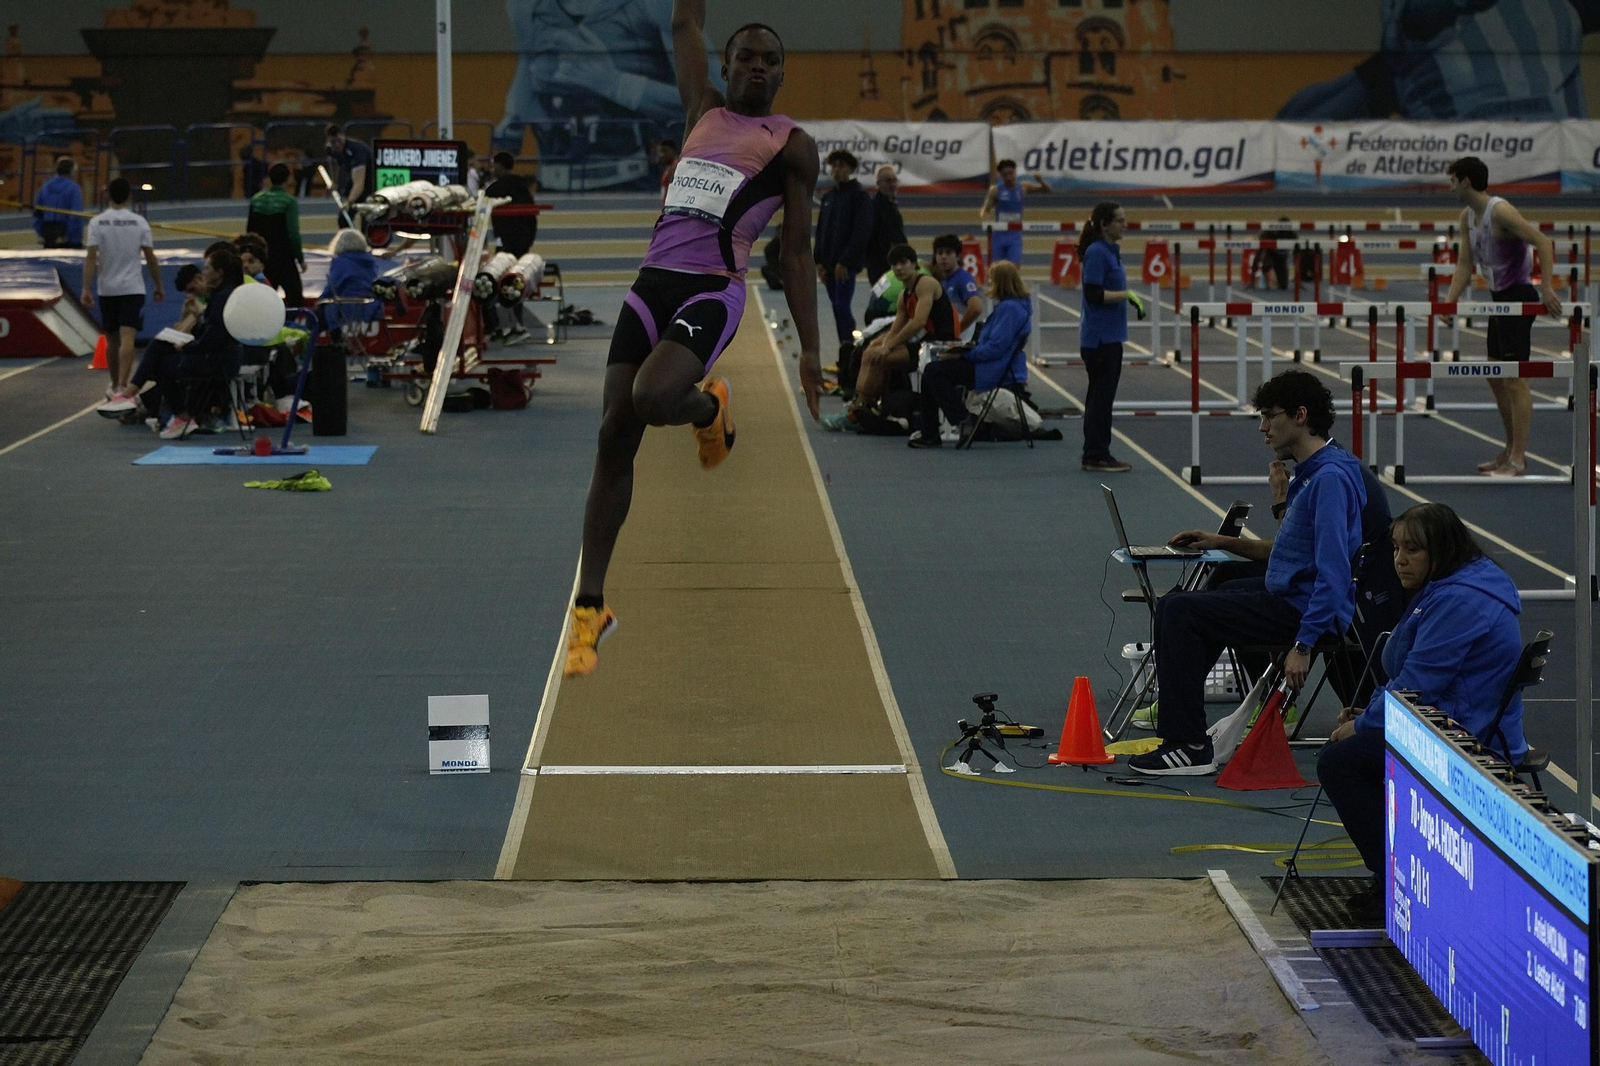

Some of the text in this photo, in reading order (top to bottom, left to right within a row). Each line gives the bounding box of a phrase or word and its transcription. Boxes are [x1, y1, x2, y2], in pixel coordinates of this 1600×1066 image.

[816, 136, 962, 160] eración Galega
[1346, 132, 1534, 158] Federación Galega
[1024, 139, 1246, 178] atletismo.gal
[1346, 158, 1367, 174] de
[685, 196, 696, 205] 70
[1059, 253, 1074, 278] 7
[1148, 253, 1167, 278] 6
[1264, 305, 1305, 314] MONDO
[1448, 365, 1501, 375] MONDO
